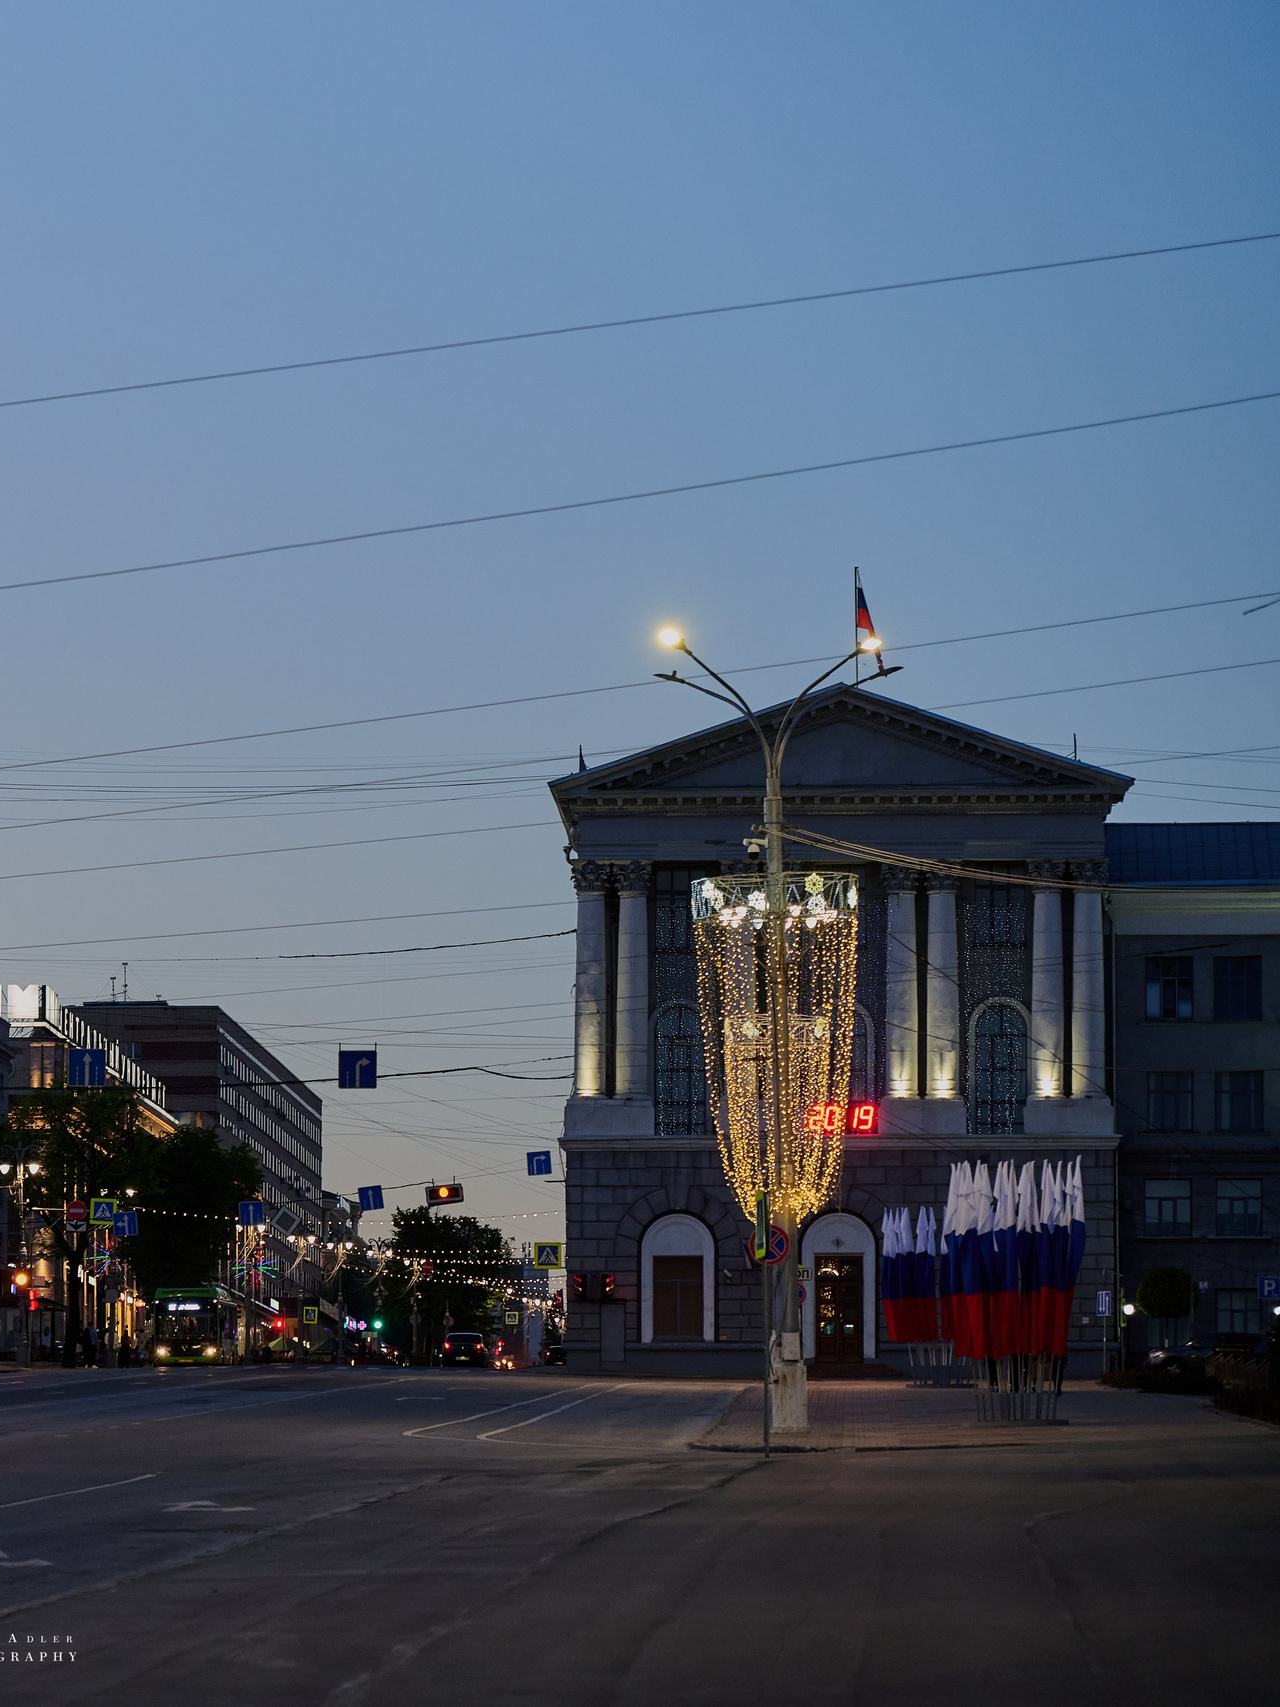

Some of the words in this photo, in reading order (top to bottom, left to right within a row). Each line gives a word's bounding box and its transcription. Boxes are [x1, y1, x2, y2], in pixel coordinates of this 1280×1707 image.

[121, 1053, 167, 1109] УНИВЕРМАГ
[852, 1105, 874, 1130] 19
[1263, 1279, 1276, 1296] P
